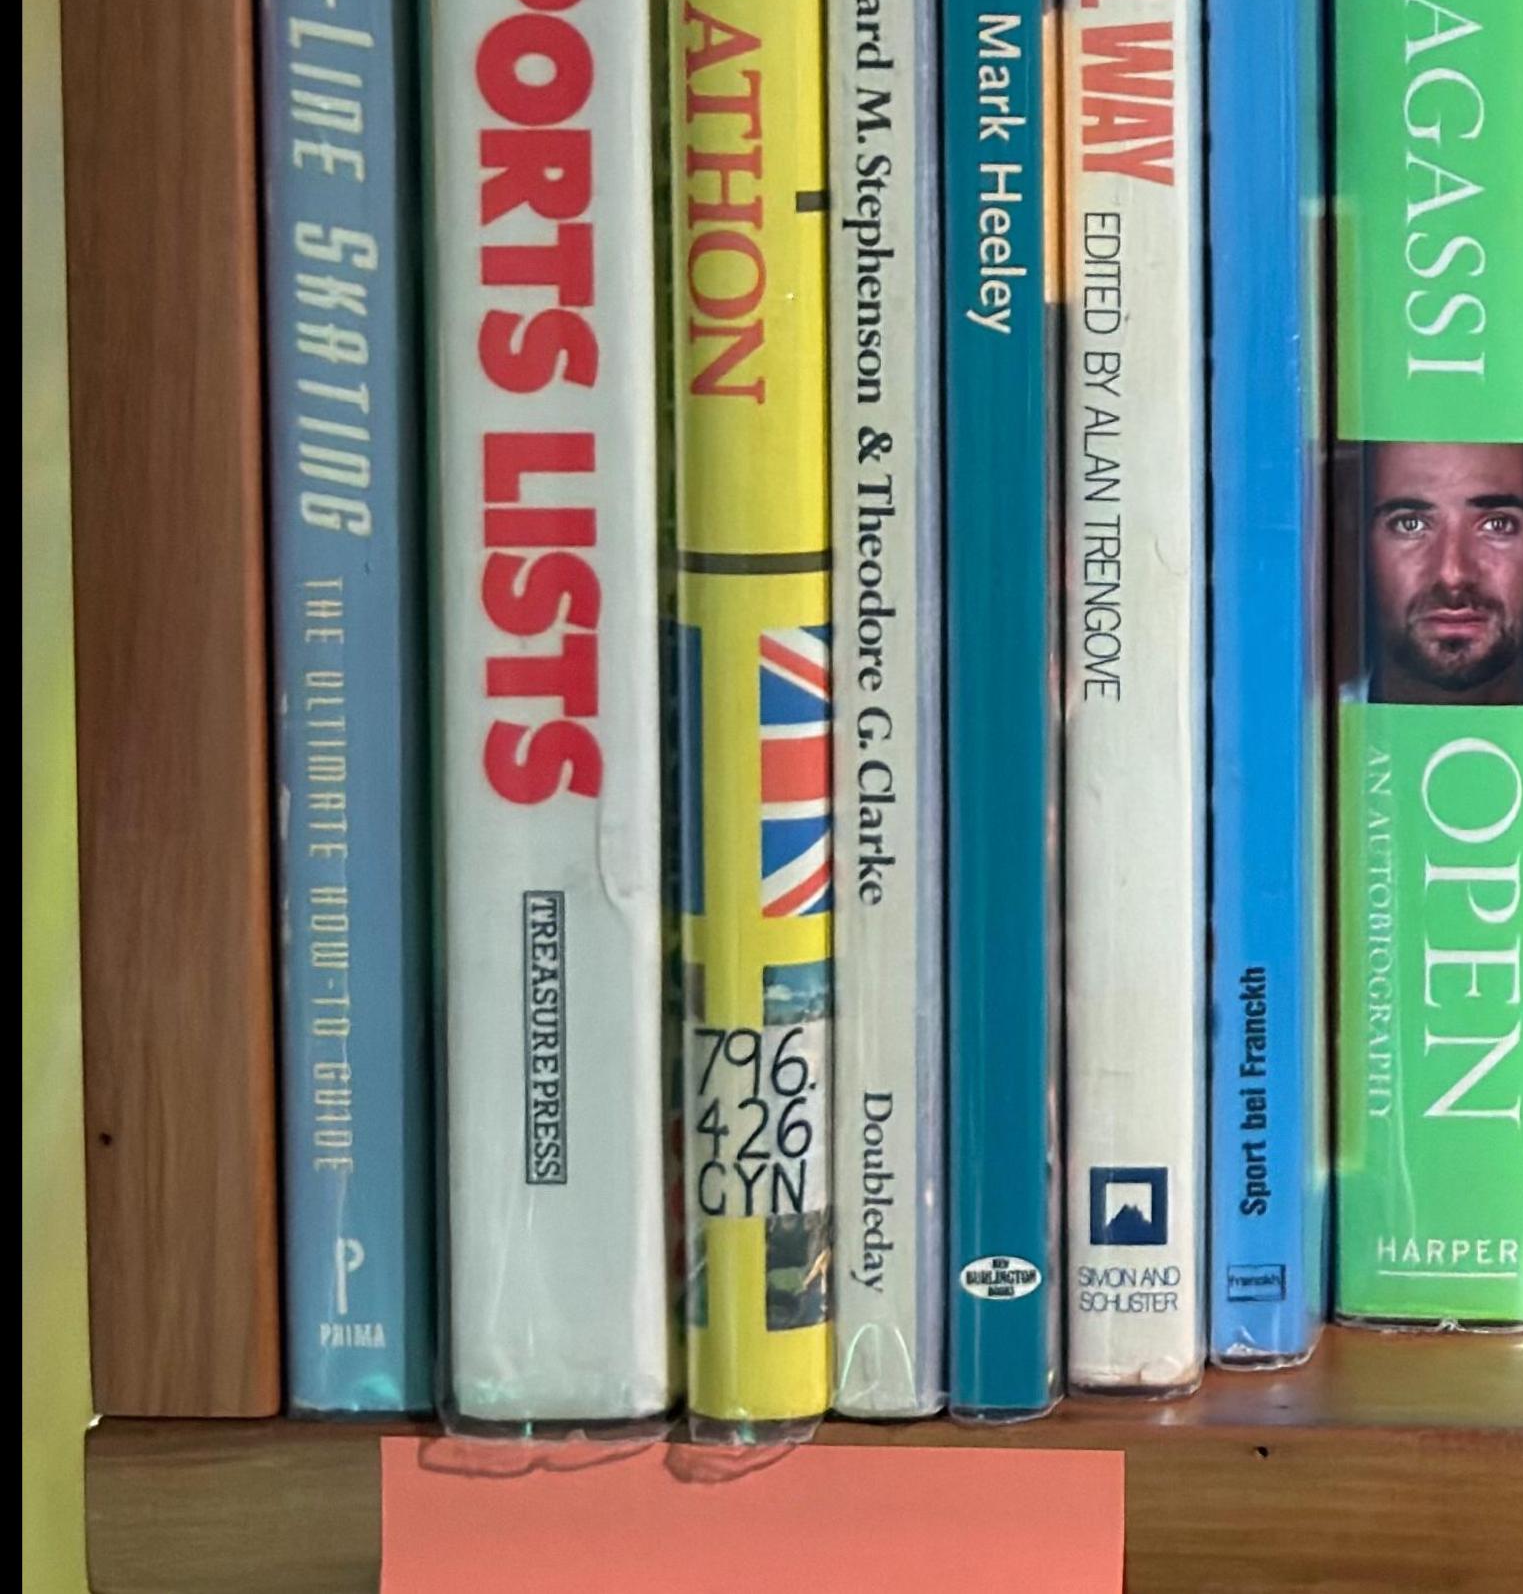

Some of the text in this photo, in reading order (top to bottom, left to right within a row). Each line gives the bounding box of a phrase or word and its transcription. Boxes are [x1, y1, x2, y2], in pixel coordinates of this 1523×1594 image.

[965, 13, 1028, 335] Mark Heeley
[1080, 21, 1175, 187] WAY
[842, 152, 895, 404] Stephenson
[1083, 212, 1121, 702] EDITED BY ALAN TRENGOVE
[482, 432, 604, 807] LISTS
[856, 473, 896, 693] Theodore
[304, 576, 354, 1176] THE ULTIMATE HOW-TO GUIDE
[856, 759, 896, 907] Clarke
[1367, 745, 1393, 1122] AN AUTOBIOGRAPHY
[1420, 737, 1523, 1130] OPEN
[696, 1097, 813, 1161] 426
[699, 1159, 807, 1218] CYN
[849, 1090, 893, 1295] Doubleday
[1377, 1236, 1519, 1265] HARPER
